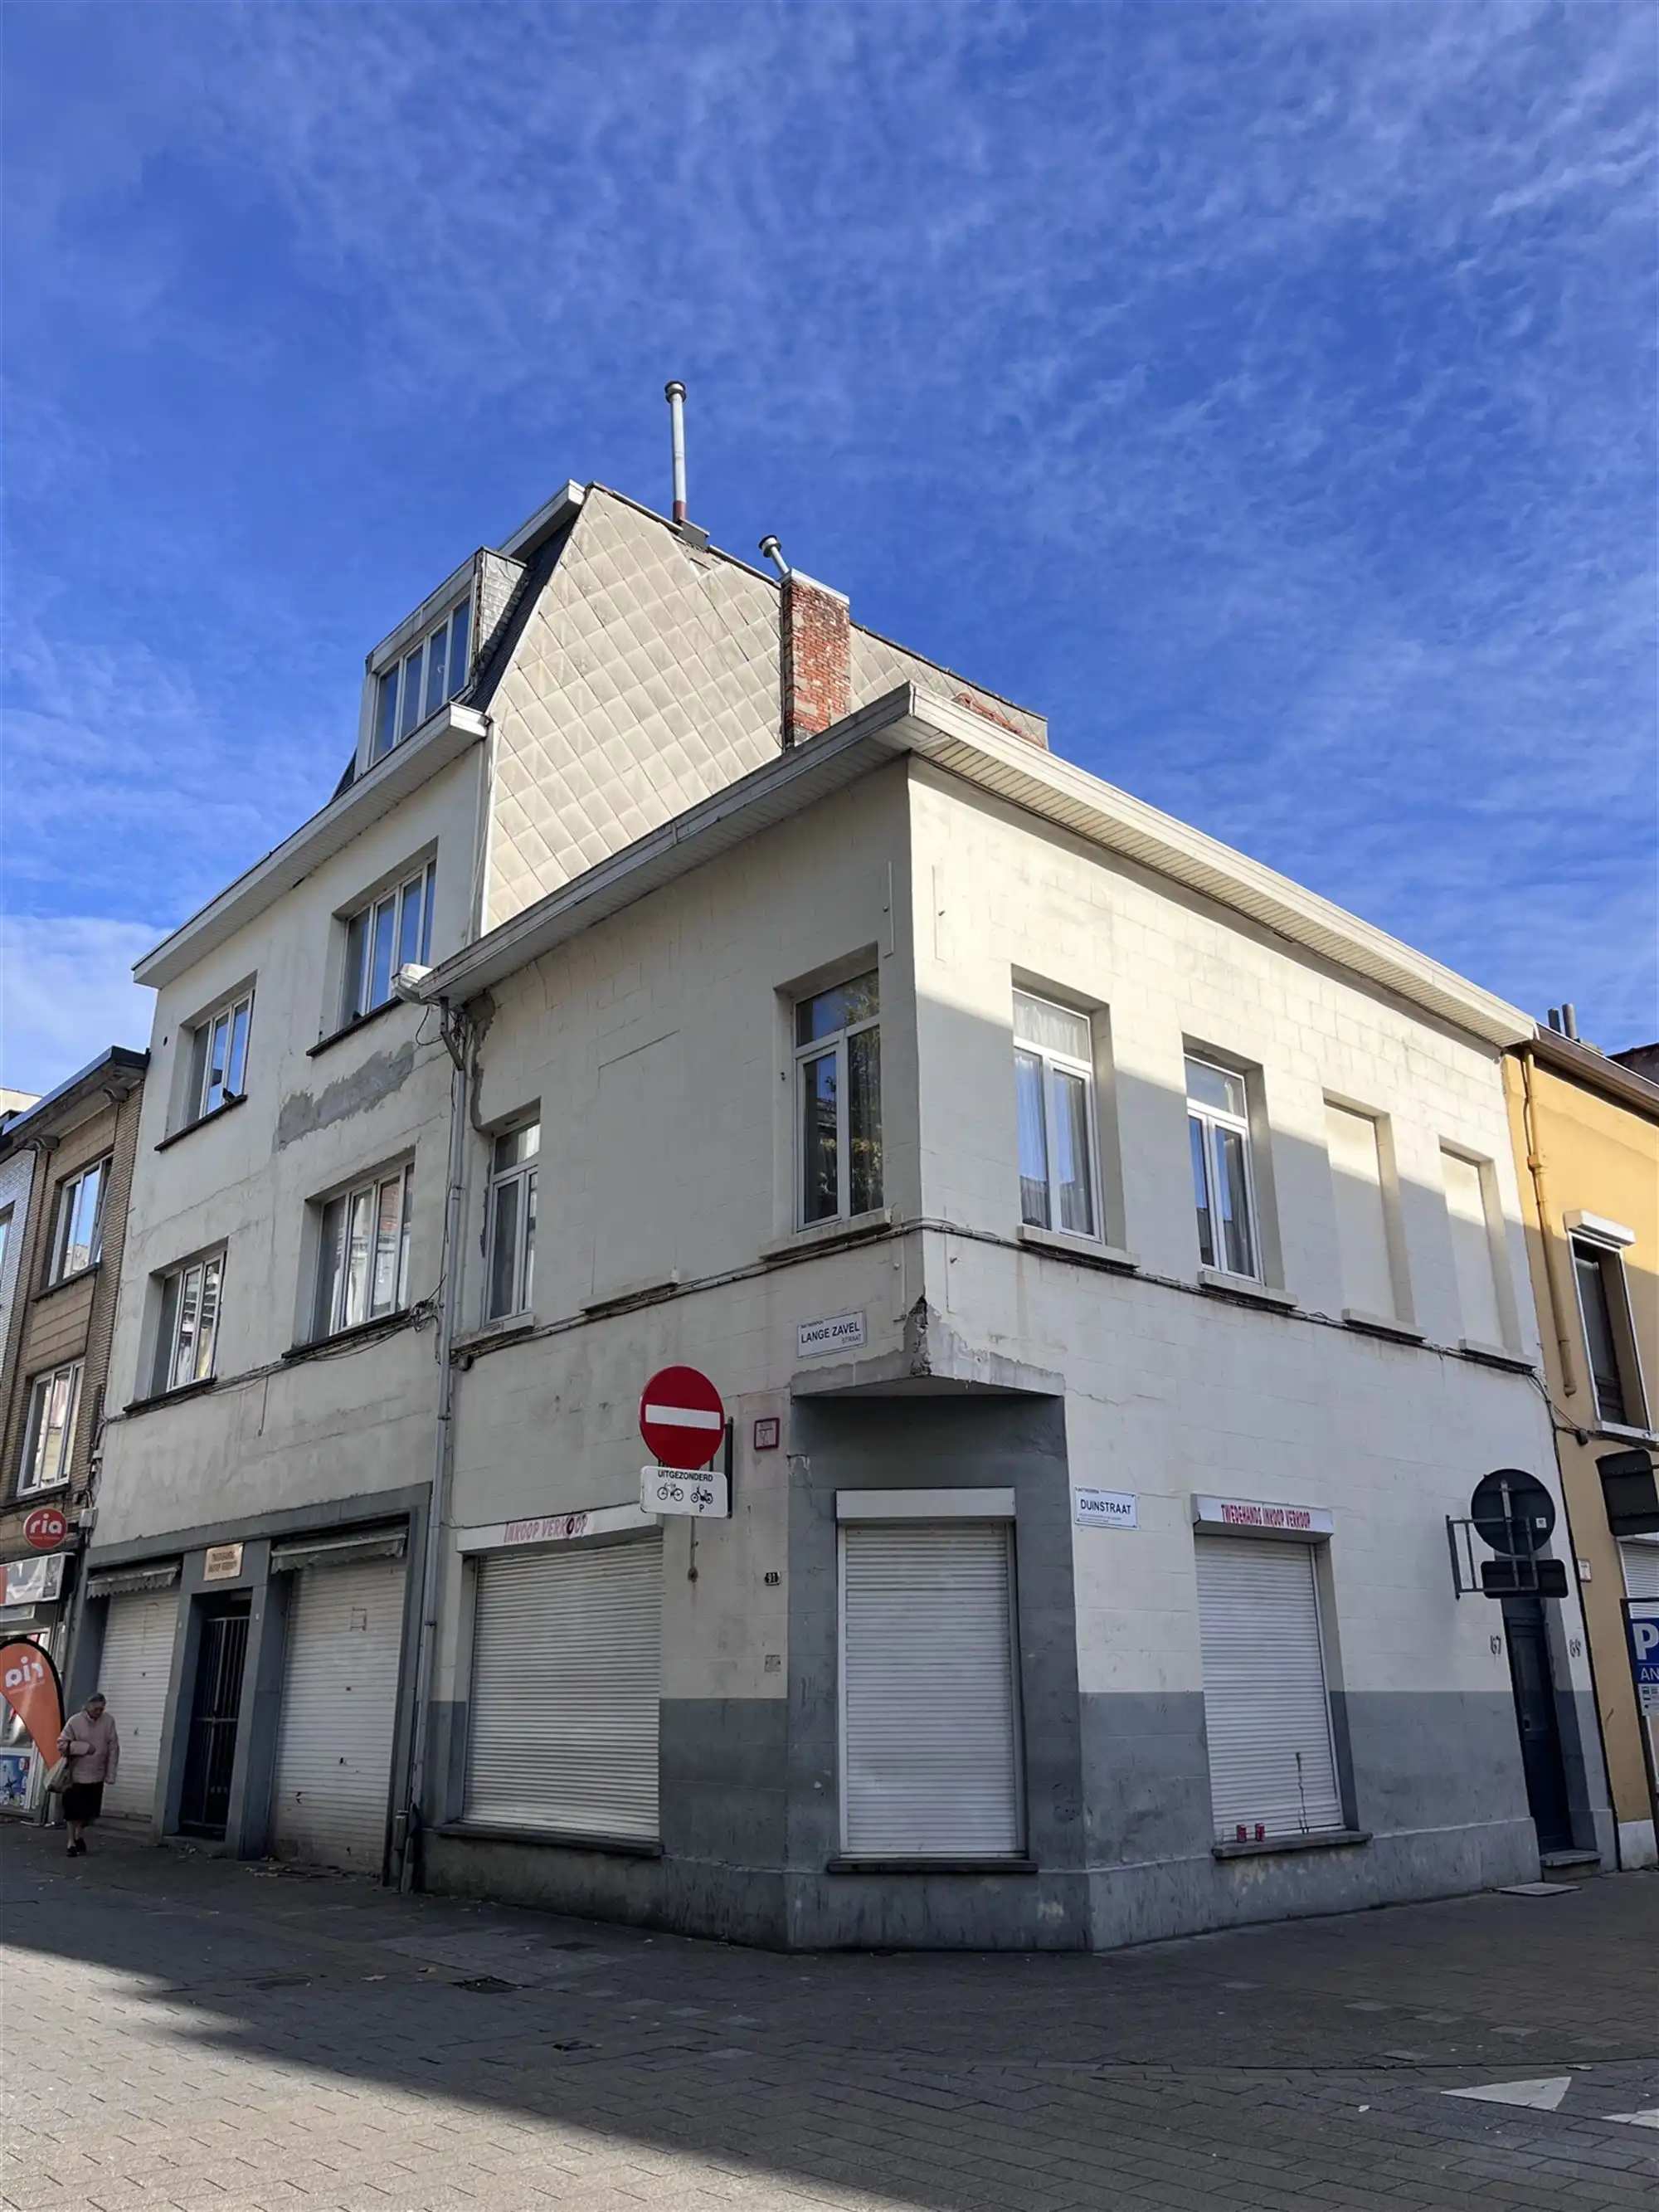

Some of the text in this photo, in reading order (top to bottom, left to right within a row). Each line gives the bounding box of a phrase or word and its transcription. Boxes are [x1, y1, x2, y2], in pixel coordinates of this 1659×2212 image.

[801, 1328, 830, 1343] LANGE
[832, 1321, 859, 1337] ZAVEL
[842, 1333, 861, 1345] STRAAT
[658, 1469, 713, 1482] UITGEZONDERD
[699, 1503, 705, 1513] P
[1080, 1498, 1131, 1515] DUINSTRAAT
[30, 1513, 62, 1534] ria
[504, 1514, 588, 1543] INKOOP VERKOOP
[1632, 1623, 1659, 1660] P
